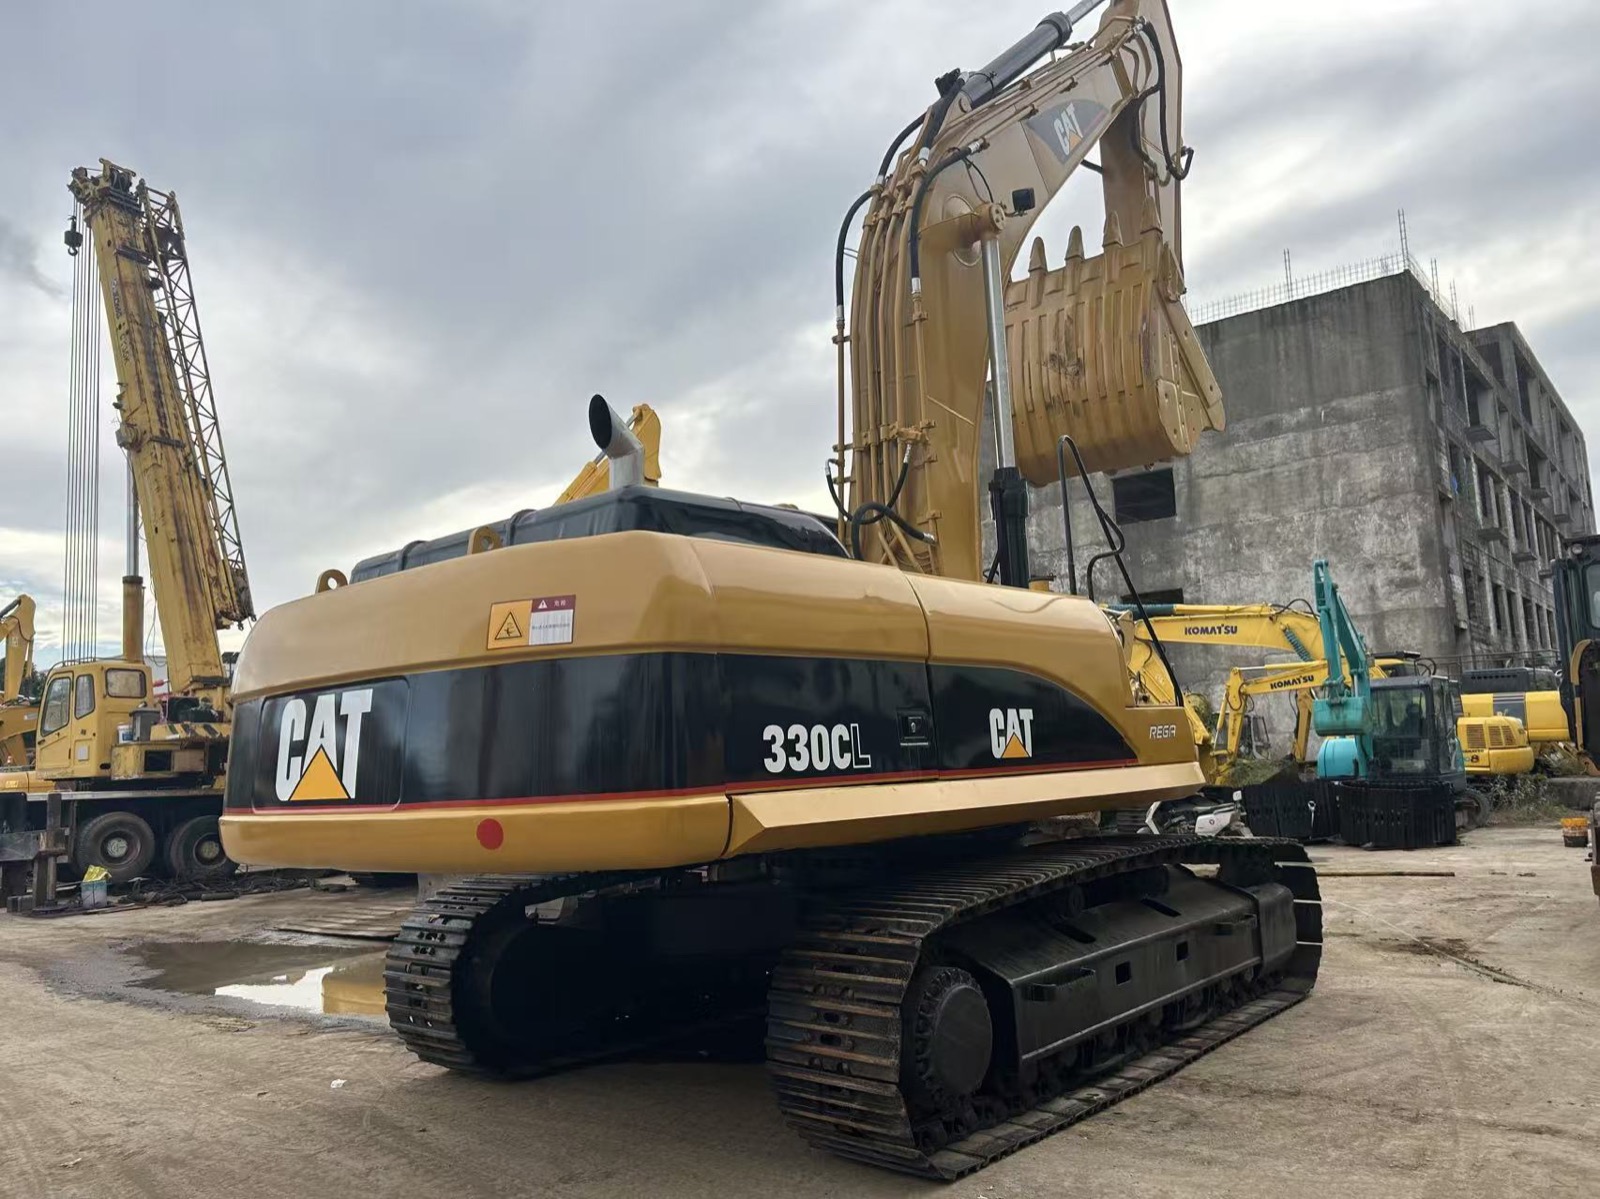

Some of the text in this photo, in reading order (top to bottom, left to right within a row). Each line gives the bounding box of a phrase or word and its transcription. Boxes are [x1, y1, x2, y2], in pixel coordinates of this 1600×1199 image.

[1053, 102, 1083, 156] CAT
[1184, 624, 1238, 635] KOMATSU
[1270, 675, 1315, 690] KOMATSU
[275, 688, 373, 802] CAT
[763, 723, 871, 774] 330CL
[989, 708, 1034, 759] CAT
[1149, 724, 1177, 739] REGA
